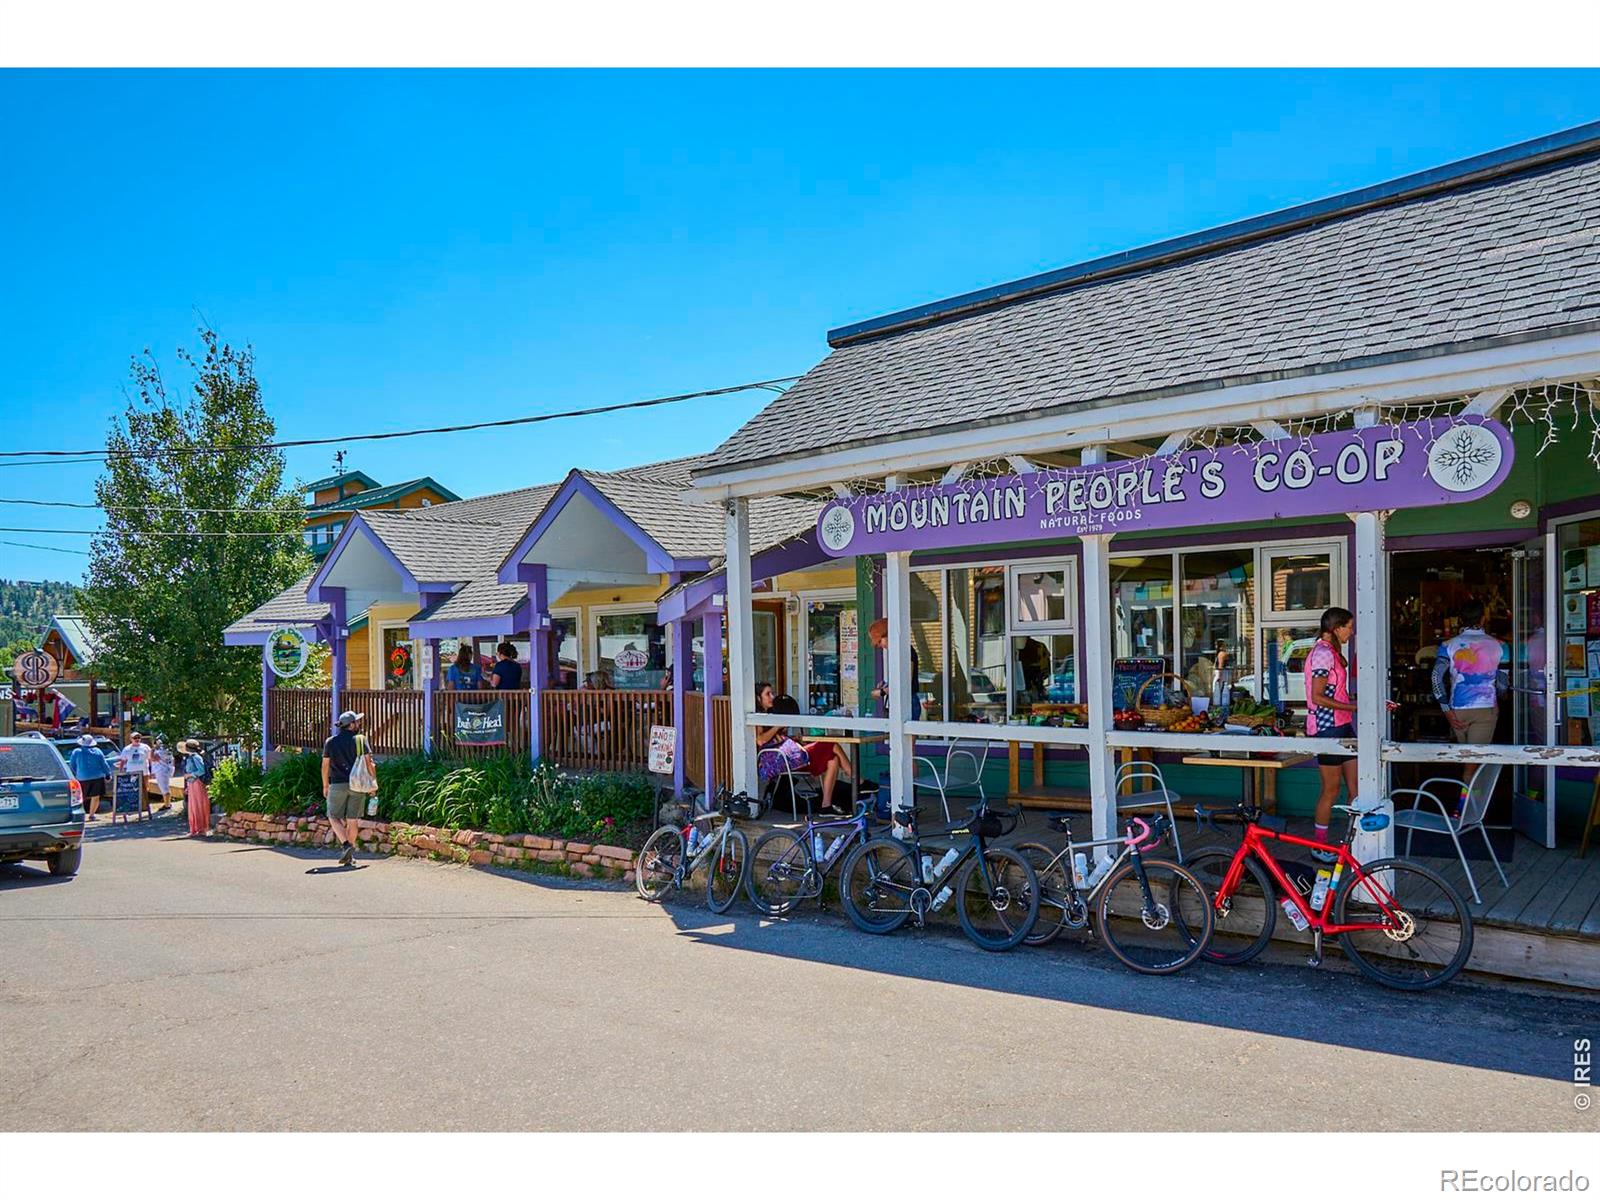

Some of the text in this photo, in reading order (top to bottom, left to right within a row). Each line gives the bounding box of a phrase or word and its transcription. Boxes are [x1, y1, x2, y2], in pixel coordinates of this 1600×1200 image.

[866, 439, 1405, 534] MOUNTAIN PEOPLE'S CO-OP
[1040, 509, 1142, 529] NATURAL FOODS
[658, 731, 669, 741] NO
